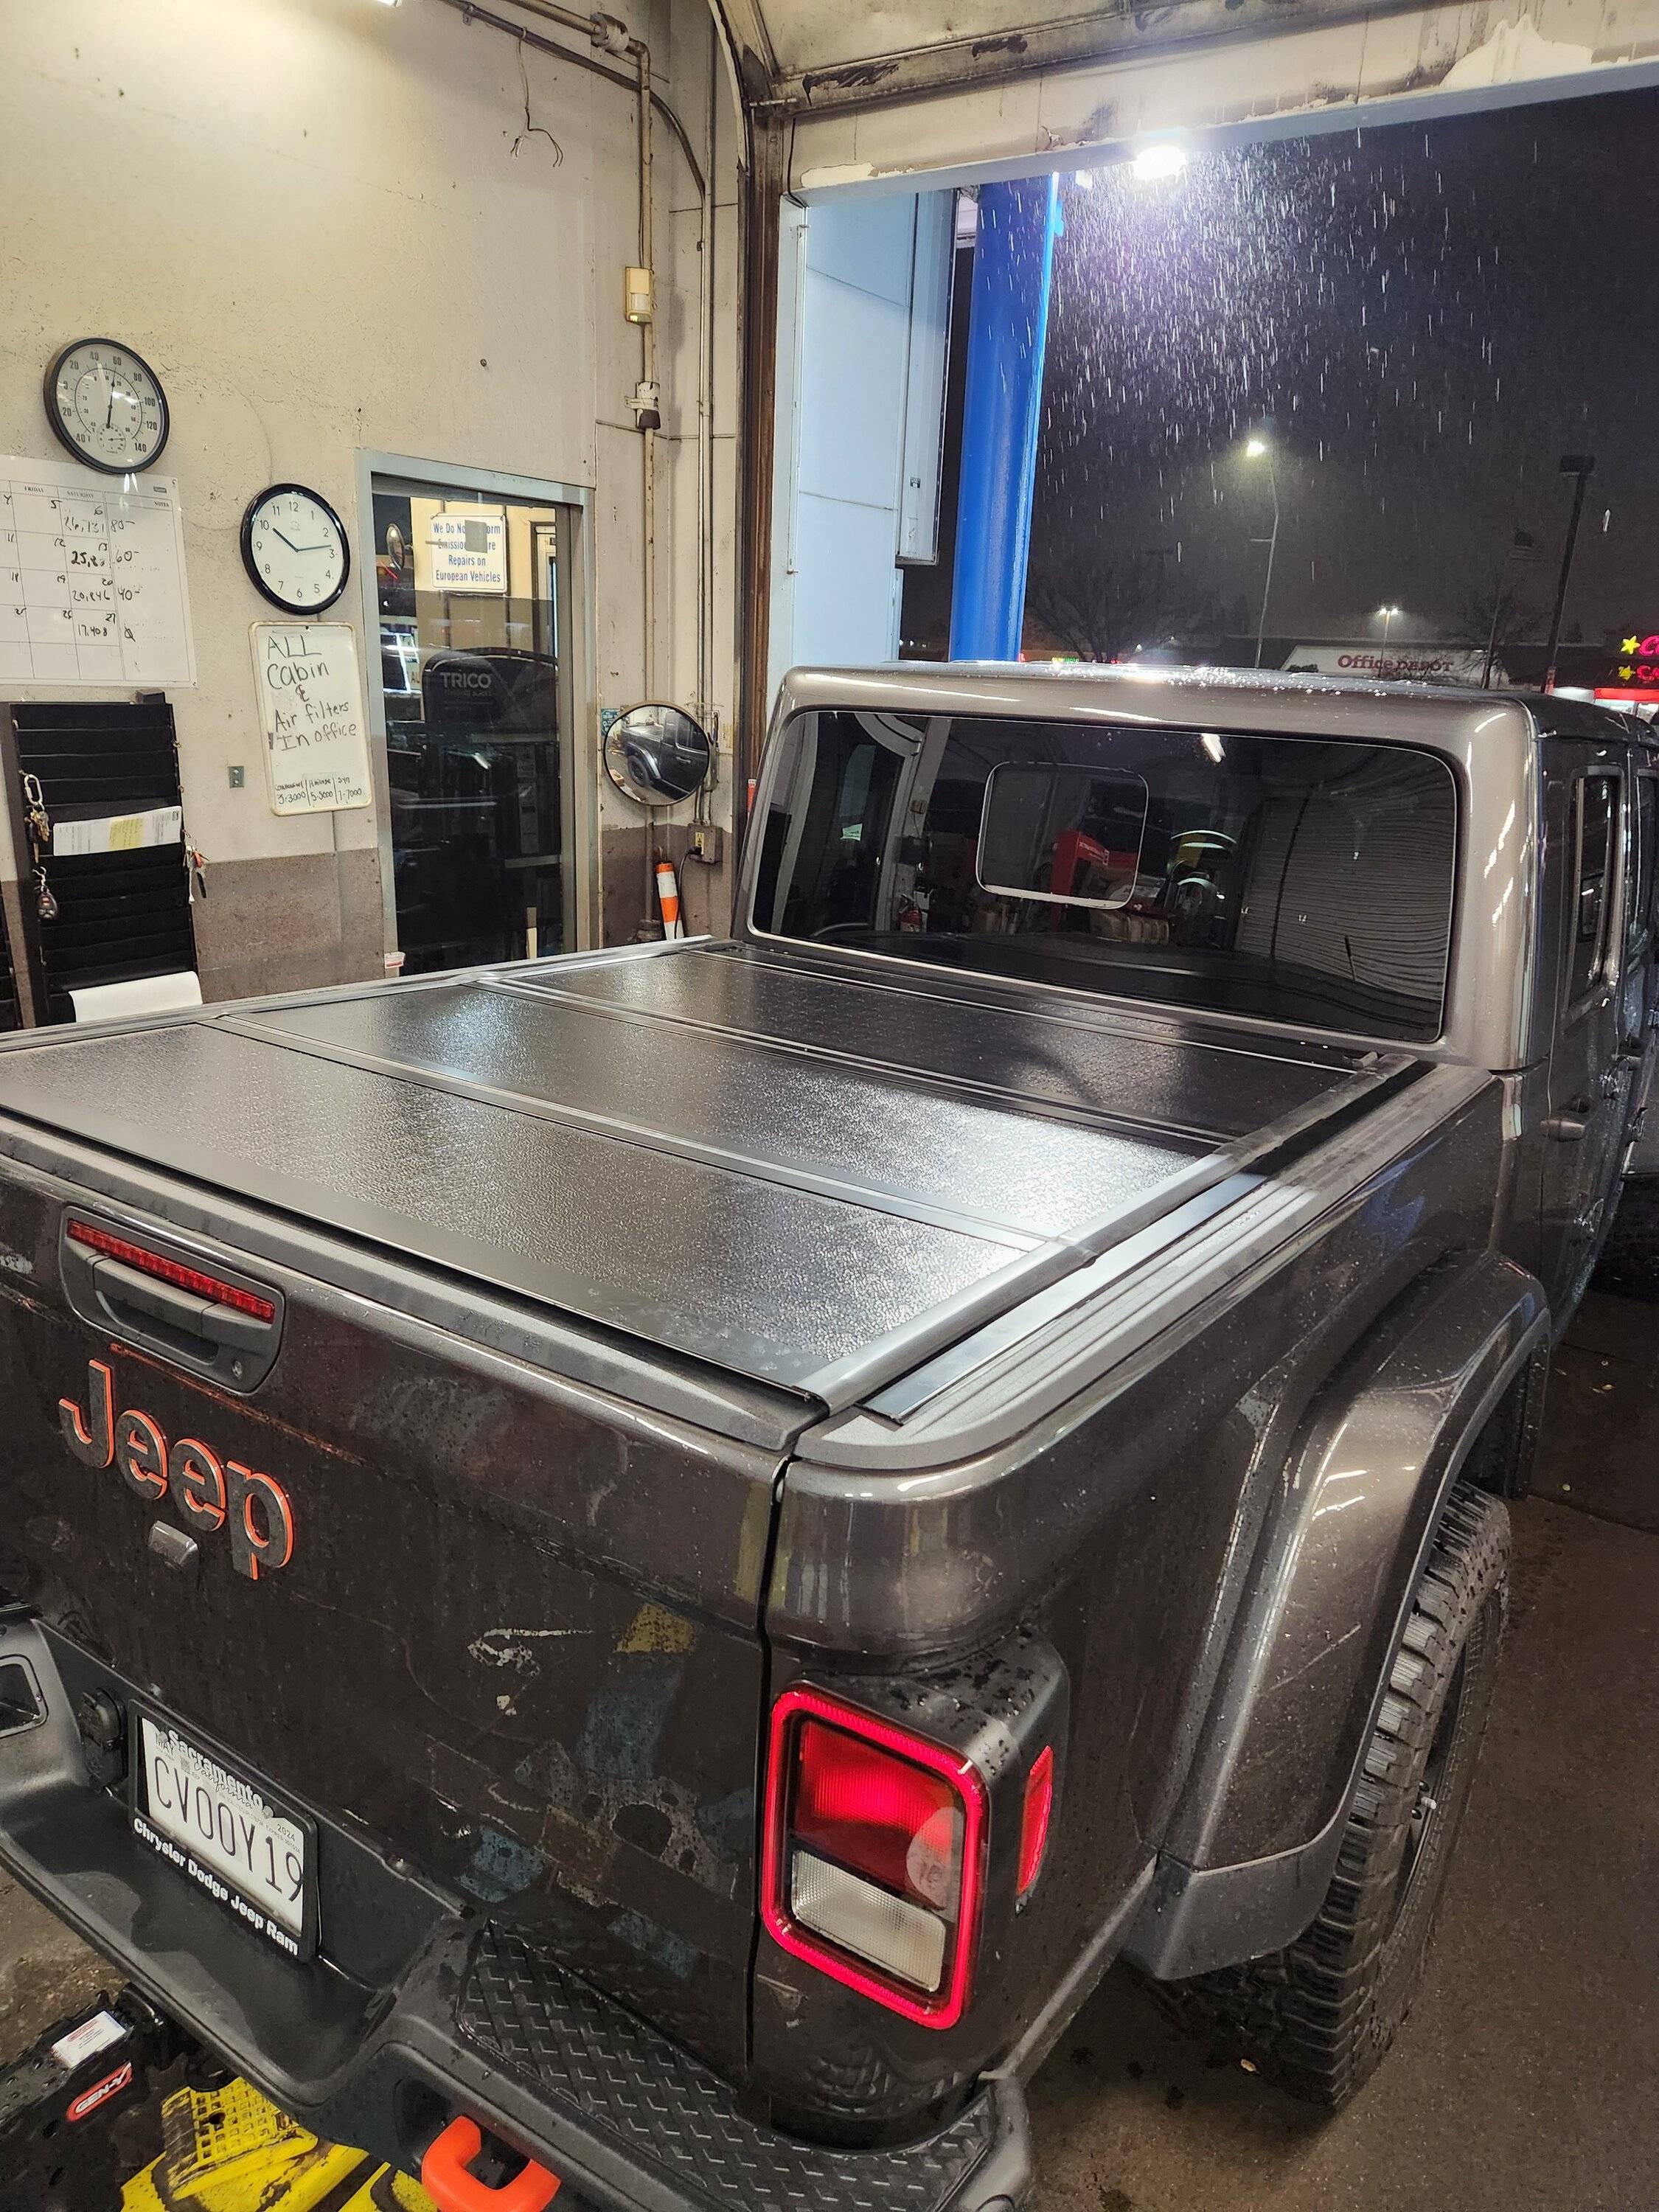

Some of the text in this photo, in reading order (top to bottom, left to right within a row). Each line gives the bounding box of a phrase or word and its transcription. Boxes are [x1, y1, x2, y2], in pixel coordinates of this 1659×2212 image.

[89, 351, 99, 361] 40
[113, 355, 122, 366] 60
[70, 360, 79, 369] 20
[133, 372, 142, 382] 80
[145, 397, 156, 407] 100
[147, 420, 158, 431] 120
[134, 442, 147, 453] 140
[66, 490, 94, 499] SATURDAY
[50, 499, 63, 509] 5
[94, 506, 103, 515] 6
[273, 504, 280, 516] 11
[289, 501, 299, 512] 12
[311, 510, 314, 520] 1
[260, 519, 270, 530] 10
[434, 523, 444, 533] We
[445, 523, 455, 534] Do
[457, 523, 465, 534] No
[323, 528, 329, 538] 2
[54, 538, 66, 548] 12
[257, 541, 262, 552] 9
[329, 549, 335, 559] 3
[448, 554, 486, 568] Repairs on
[264, 563, 271, 574] 8
[325, 569, 331, 580] 4
[436, 569, 501, 583] European Vehicles
[57, 575, 66, 584] 19
[102, 578, 114, 586] 20
[278, 580, 284, 591] 7
[296, 588, 302, 598] 6
[314, 583, 320, 594] 5
[267, 635, 323, 659] ALL
[1338, 654, 1394, 669] Office
[267, 662, 330, 689] Cabin
[439, 672, 491, 689] TRICO
[275, 700, 349, 733] Air filters
[276, 723, 357, 751] In office
[59, 1358, 295, 1581] Jeep
[168, 1729, 264, 1810] Sacramento
[133, 1817, 299, 1956] Chrysler Dodge Jeep Ram
